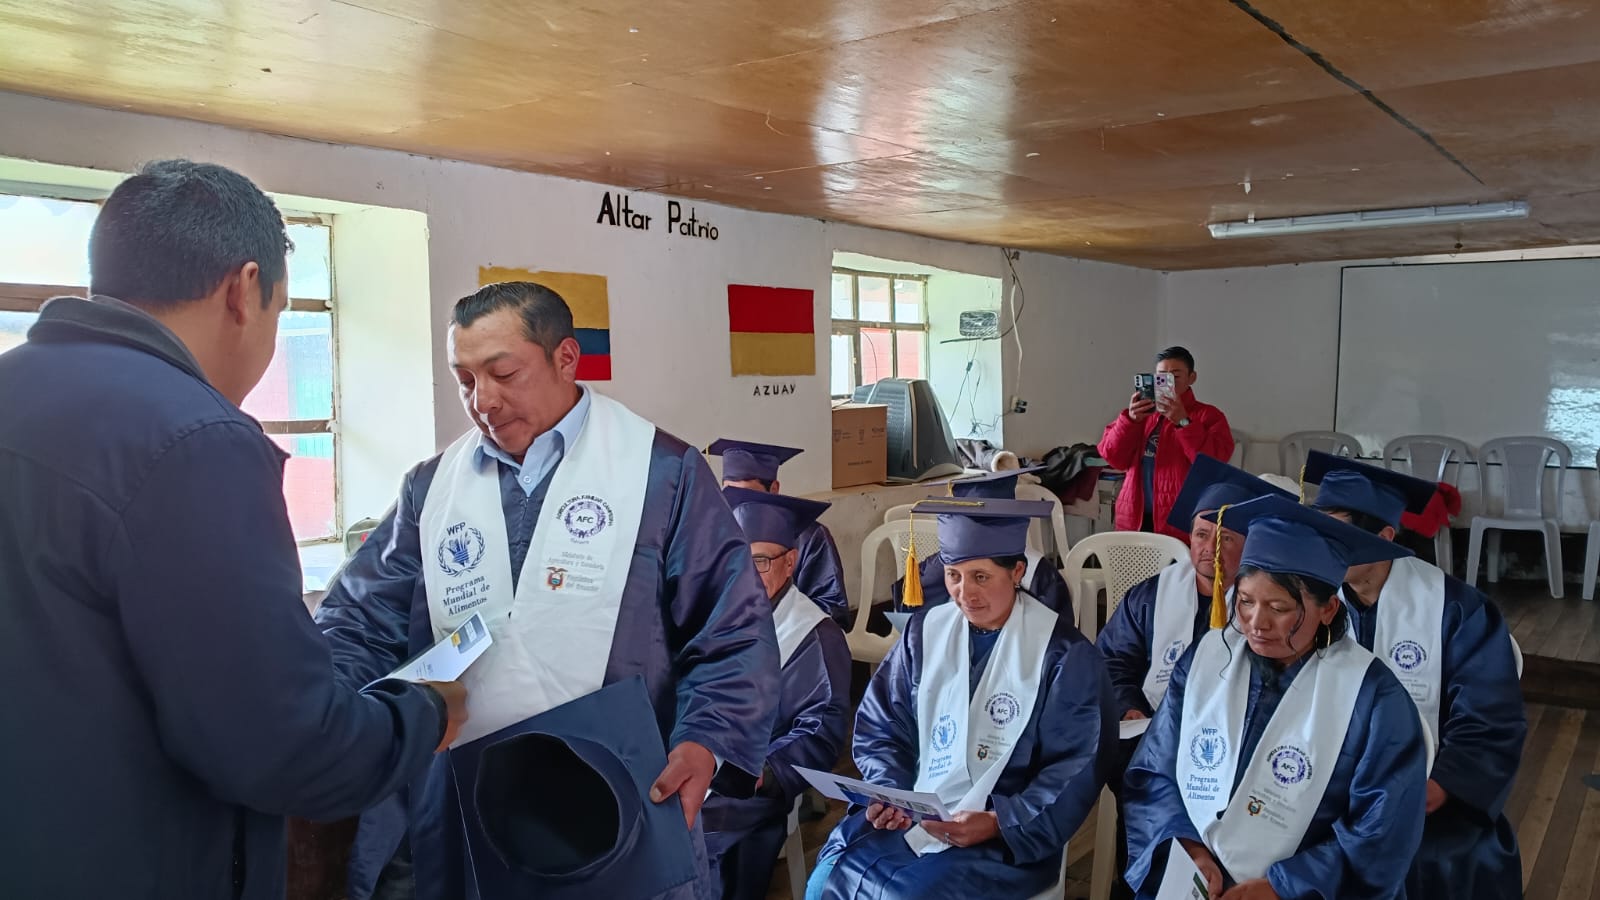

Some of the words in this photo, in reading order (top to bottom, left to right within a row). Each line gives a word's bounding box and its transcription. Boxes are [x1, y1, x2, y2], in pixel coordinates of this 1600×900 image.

[597, 191, 652, 230] Altar
[668, 200, 719, 240] Patrio
[753, 384, 796, 396] AZUAY
[576, 515, 594, 524] AFC
[446, 521, 466, 536] WFP
[446, 575, 485, 596] Programa
[443, 587, 477, 607] Mundial
[480, 583, 490, 593] de
[448, 596, 487, 616] Alimentos
[1202, 727, 1218, 736] WFP
[1281, 762, 1296, 773] AFC
[1190, 774, 1218, 783] Programa
[1186, 782, 1211, 792] Mundial
